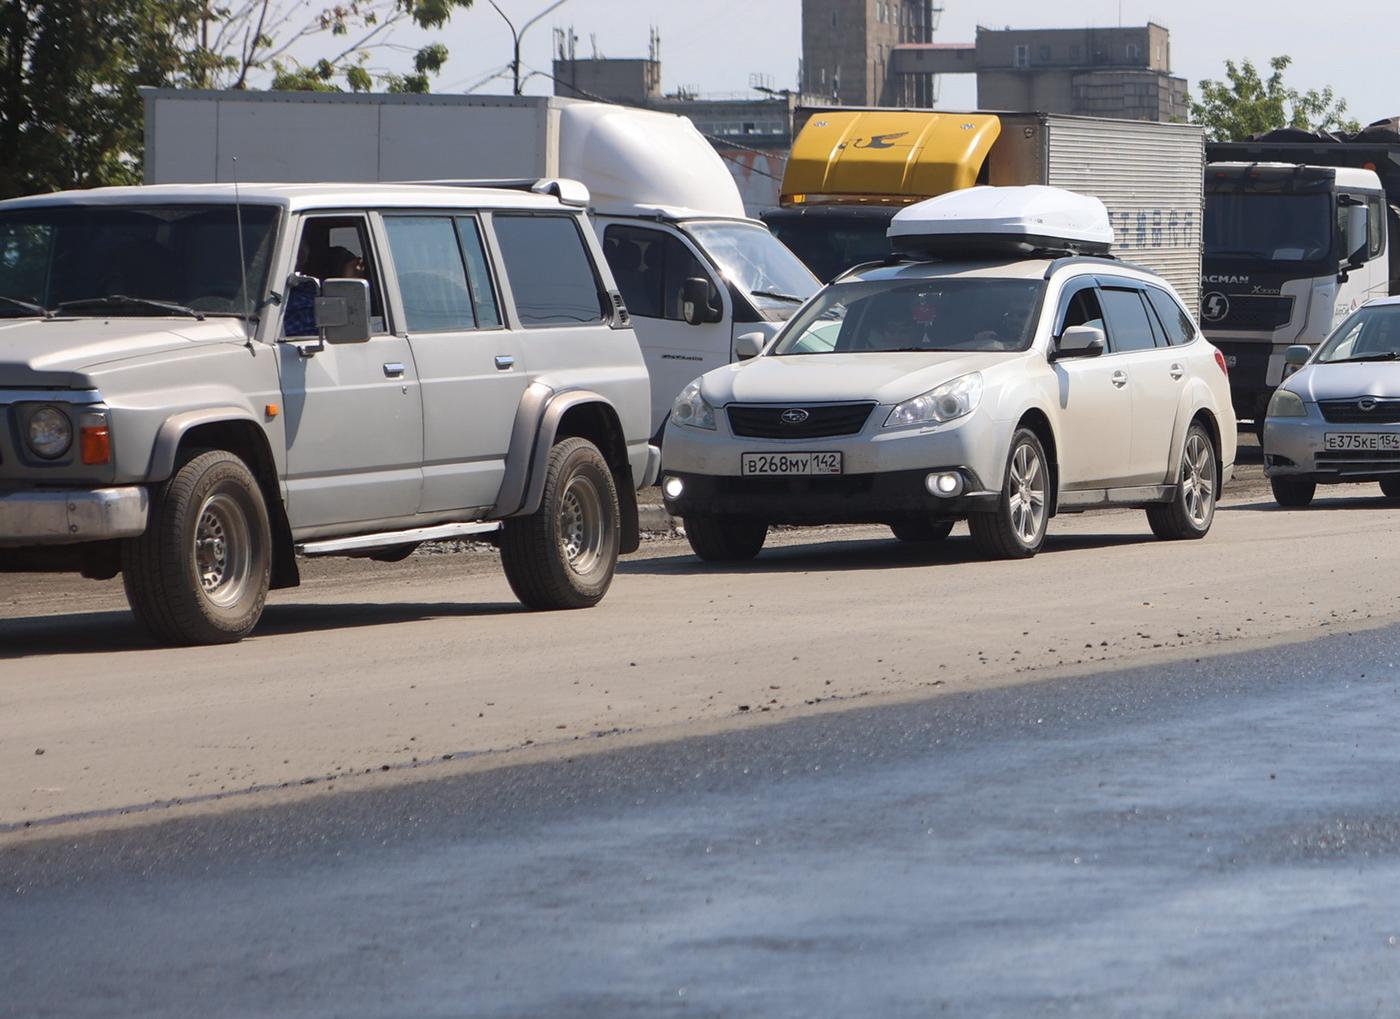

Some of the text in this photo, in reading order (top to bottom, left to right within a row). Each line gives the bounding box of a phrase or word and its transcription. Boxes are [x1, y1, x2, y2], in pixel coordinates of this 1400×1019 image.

[1201, 275, 1249, 284] ACMAN
[1329, 435, 1400, 448] Е375КЕ 154
[748, 454, 837, 473] В268МУ 142
